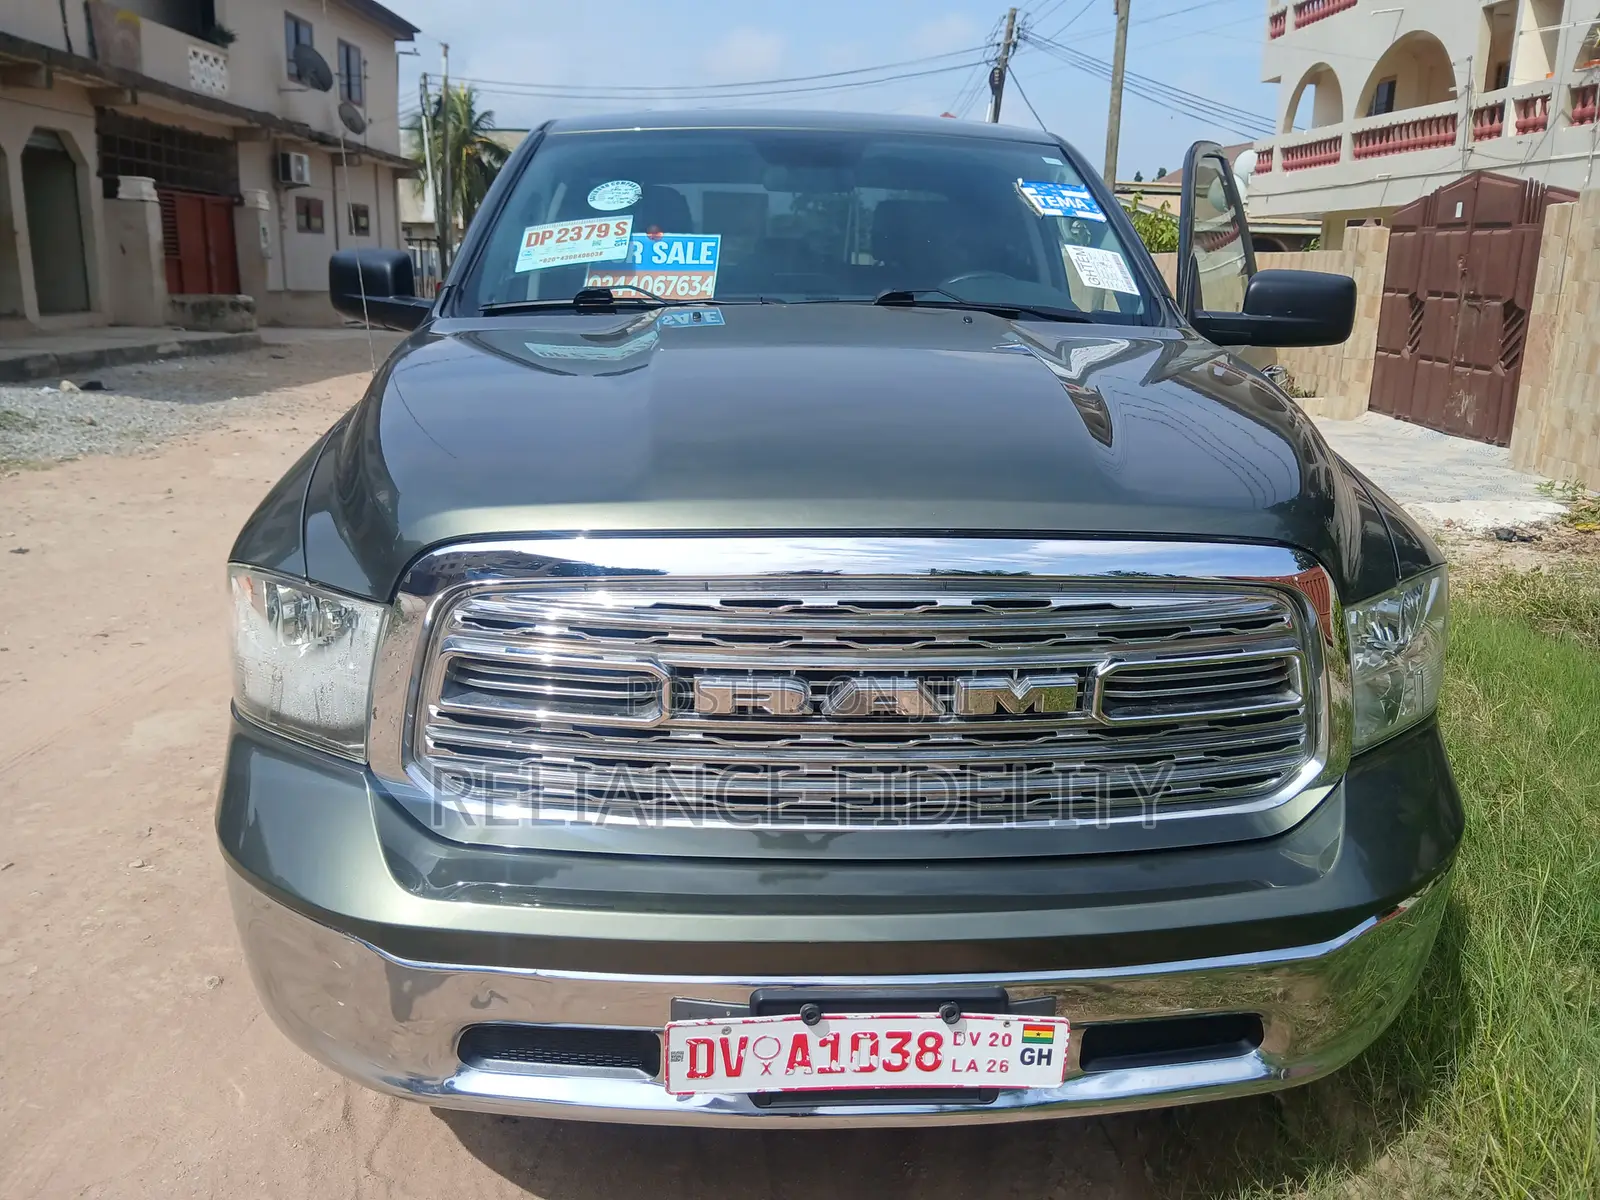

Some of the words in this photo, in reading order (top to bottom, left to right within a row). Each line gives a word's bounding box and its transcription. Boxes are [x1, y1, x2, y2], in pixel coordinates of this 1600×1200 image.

[1032, 195, 1091, 210] TEMA
[526, 230, 554, 248] DP
[555, 223, 611, 244] 2379
[614, 221, 629, 236] S
[652, 241, 716, 265] SALE
[695, 673, 1079, 716] RAM
[988, 1033, 1012, 1047] 20
[686, 1036, 749, 1079] DV
[951, 1059, 979, 1073] LA
[986, 1060, 1010, 1073] 26
[1019, 1047, 1053, 1066] GH
